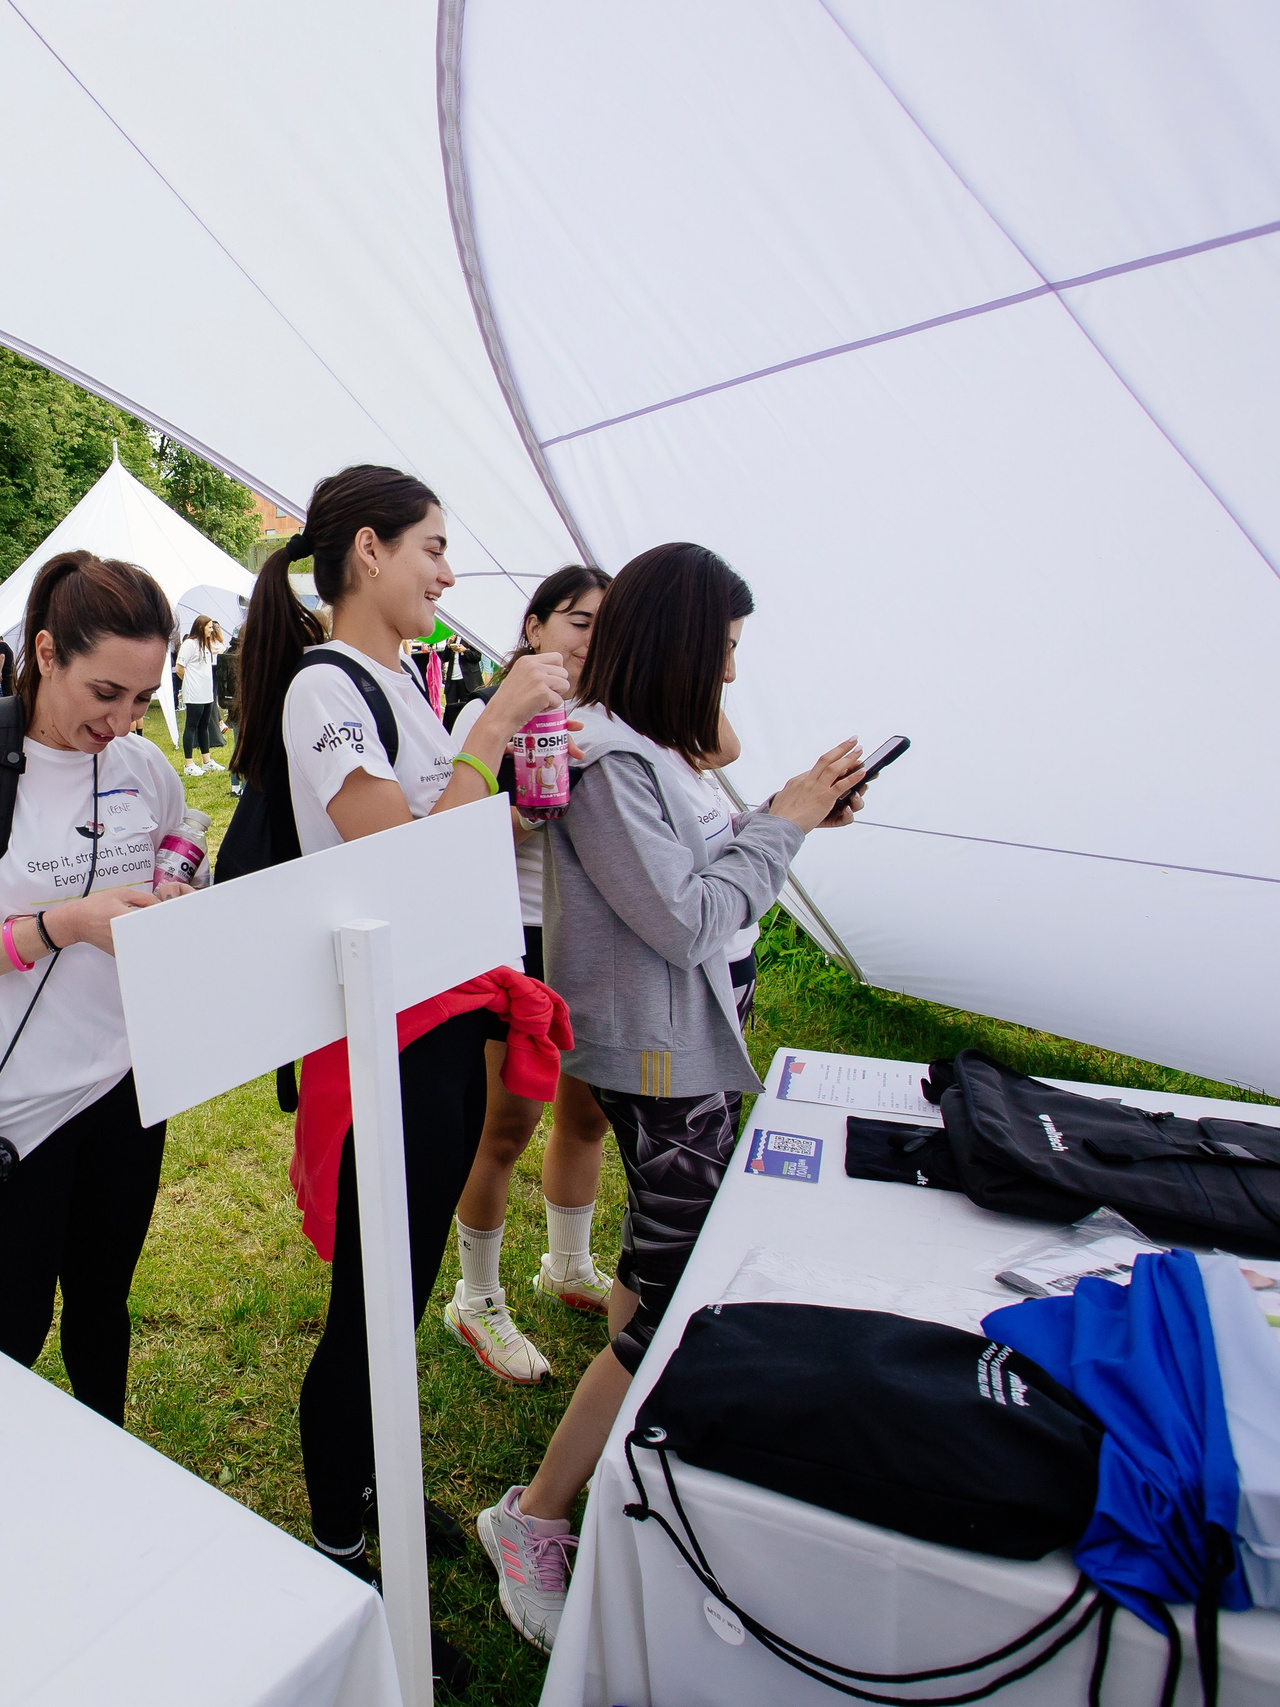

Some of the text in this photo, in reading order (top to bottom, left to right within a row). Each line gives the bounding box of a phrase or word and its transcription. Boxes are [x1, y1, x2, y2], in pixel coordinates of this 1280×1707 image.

[107, 803, 131, 816] IRENE
[27, 857, 59, 874] Step
[60, 854, 74, 870] it,
[115, 844, 127, 860] it,
[128, 840, 152, 855] boost
[54, 872, 87, 888] Every
[121, 858, 152, 873] counts
[982, 1342, 999, 1361] AND
